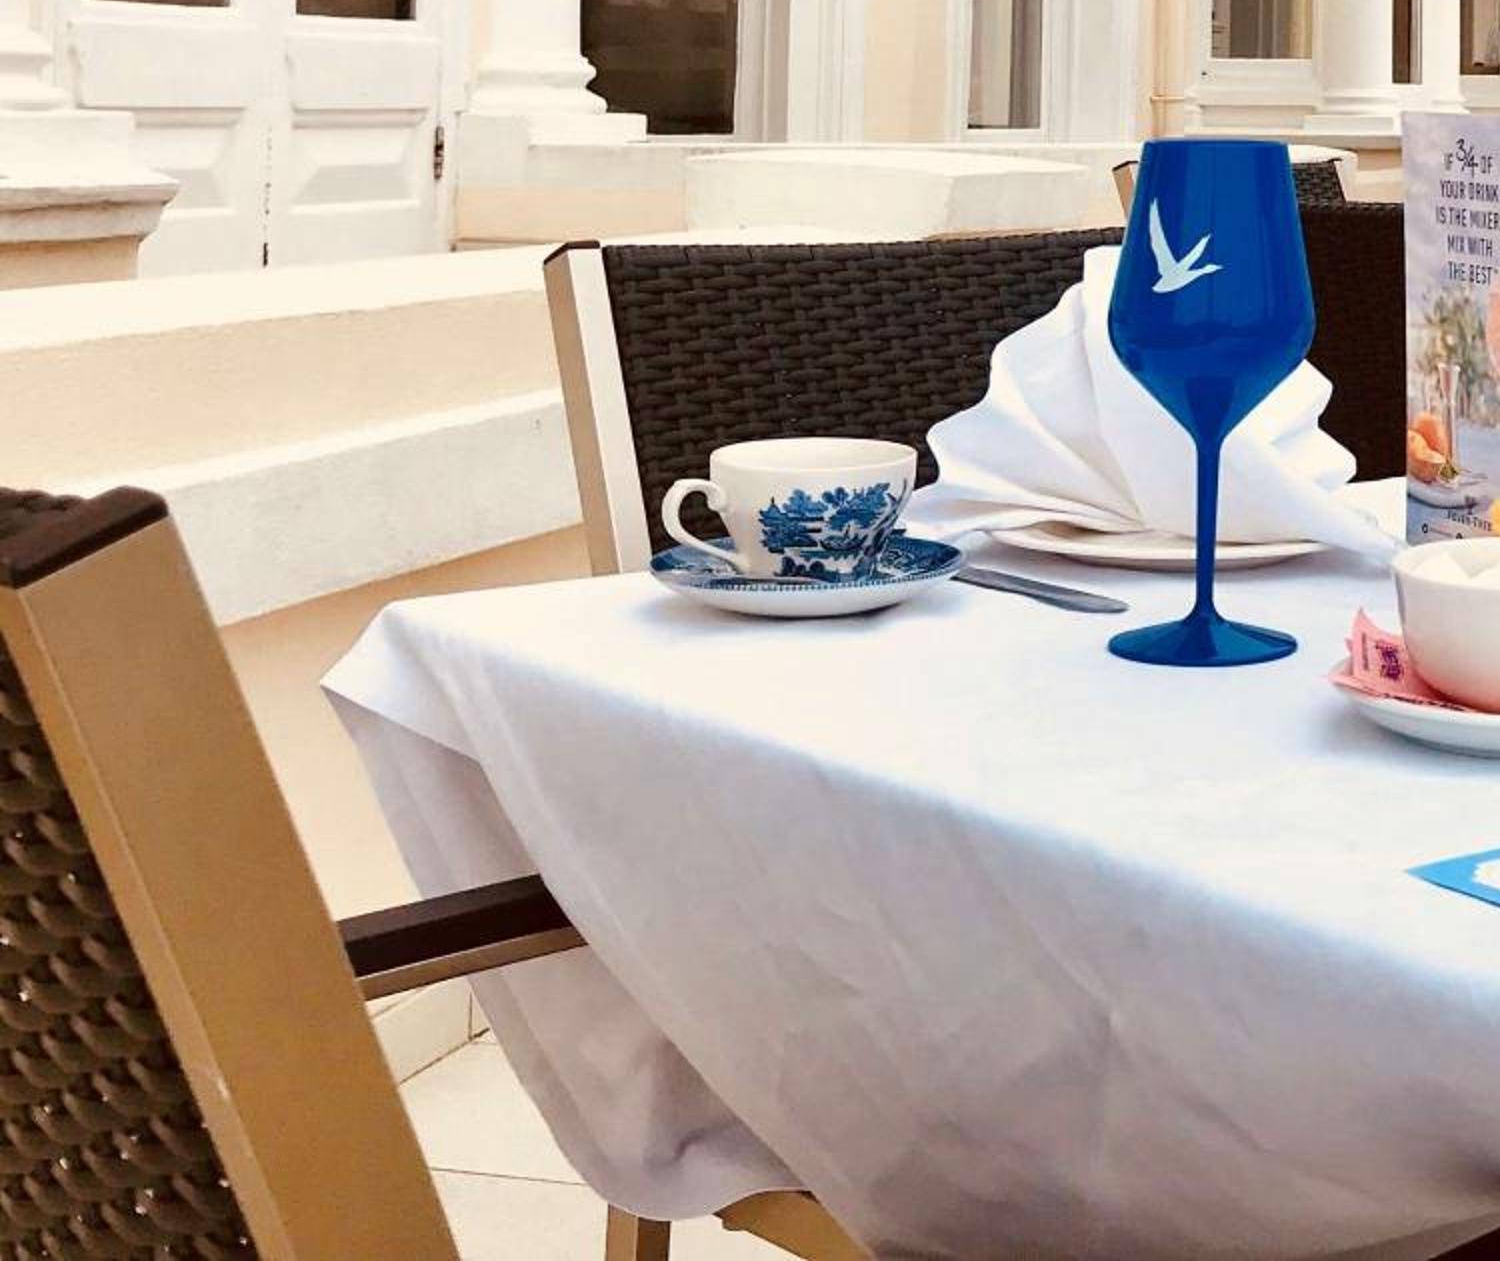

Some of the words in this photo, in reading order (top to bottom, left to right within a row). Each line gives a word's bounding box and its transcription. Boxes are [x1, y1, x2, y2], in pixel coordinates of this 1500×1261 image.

[1481, 155, 1493, 174] OF
[1440, 179, 1465, 200] YOUR
[1468, 182, 1500, 203] DRINK
[1436, 206, 1446, 225] IS
[1449, 207, 1467, 227] THE
[1447, 234, 1465, 253] MIX
[1468, 237, 1493, 257] WITH
[1448, 261, 1466, 282] THE
